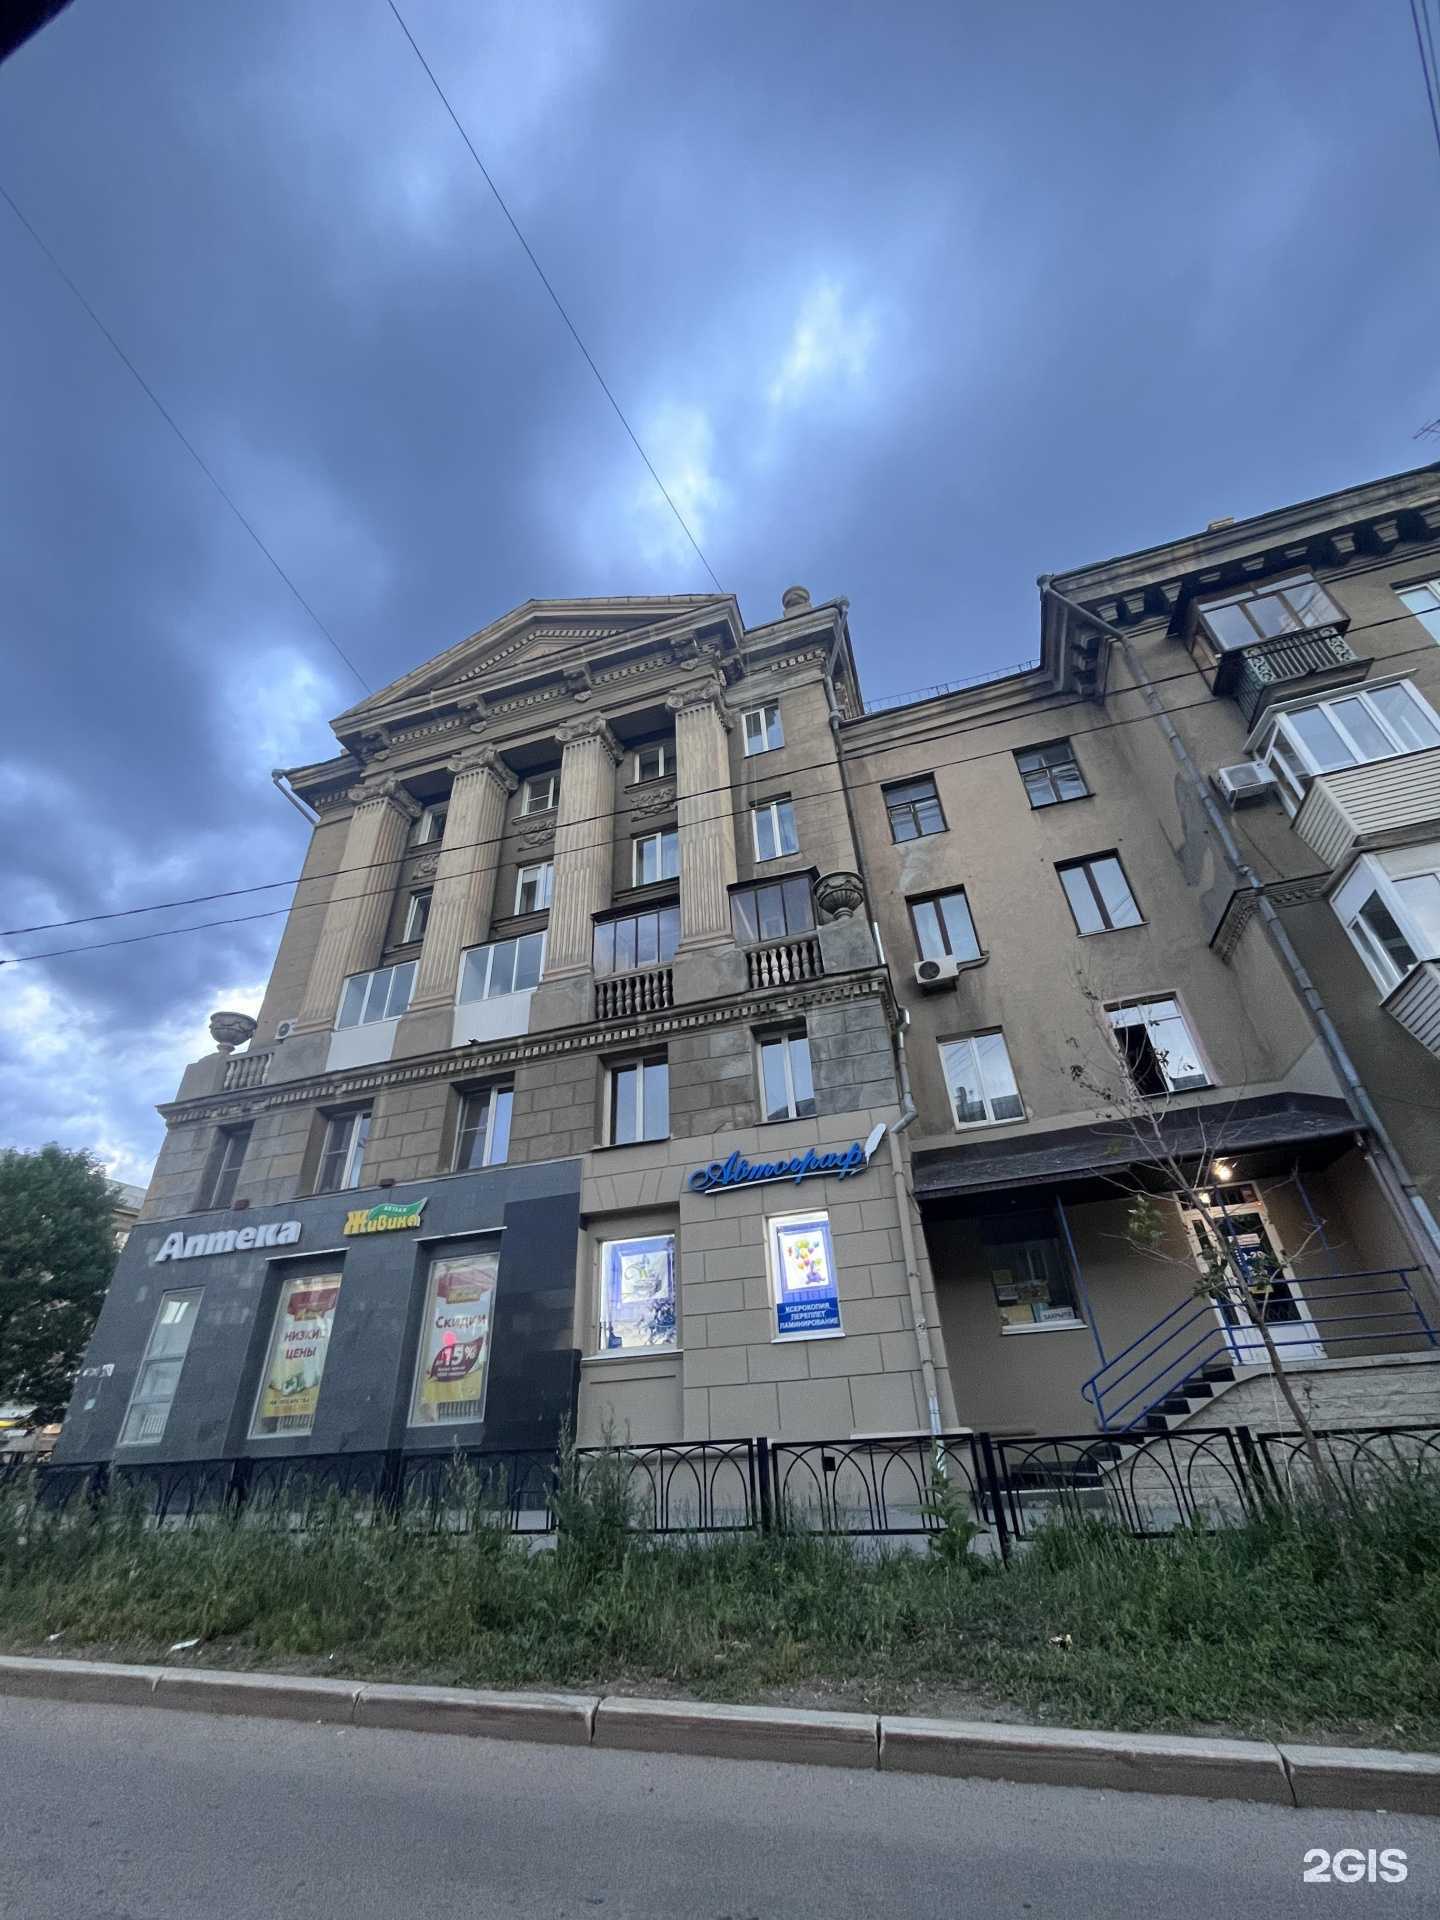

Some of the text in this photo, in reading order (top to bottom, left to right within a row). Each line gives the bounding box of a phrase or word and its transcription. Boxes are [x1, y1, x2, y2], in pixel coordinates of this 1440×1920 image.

[687, 1141, 865, 1191] Автограф
[154, 1220, 302, 1262] Аптека
[285, 1347, 317, 1361] ЦЕНЫ
